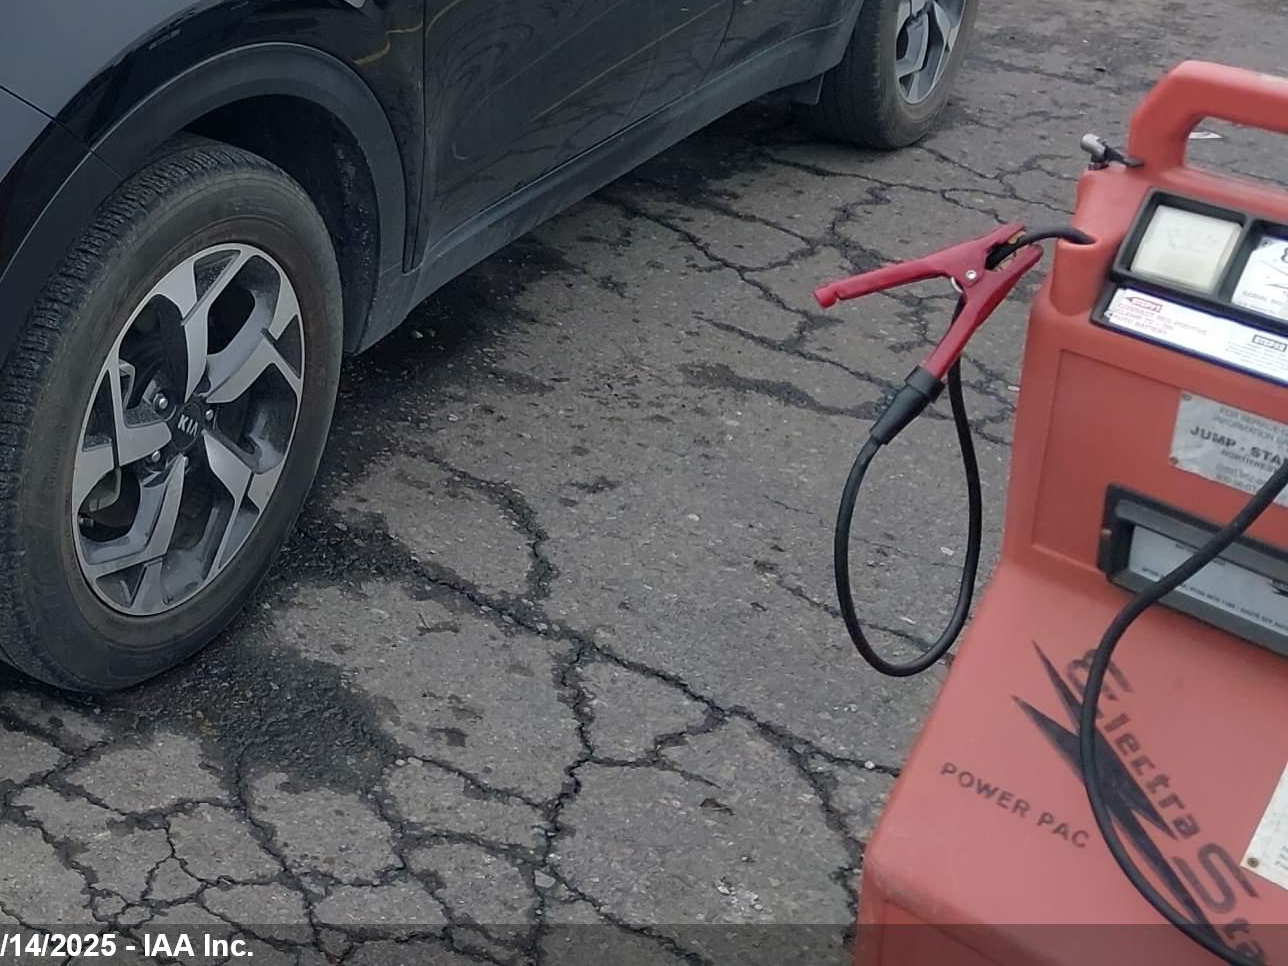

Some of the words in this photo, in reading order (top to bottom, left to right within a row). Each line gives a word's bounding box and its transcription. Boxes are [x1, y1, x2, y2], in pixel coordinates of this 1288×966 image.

[178, 414, 198, 437] KIA
[1190, 426, 1237, 447] JUMP
[1251, 446, 1282, 466] STA
[940, 762, 1031, 819] POWER
[1037, 812, 1090, 849] PAC
